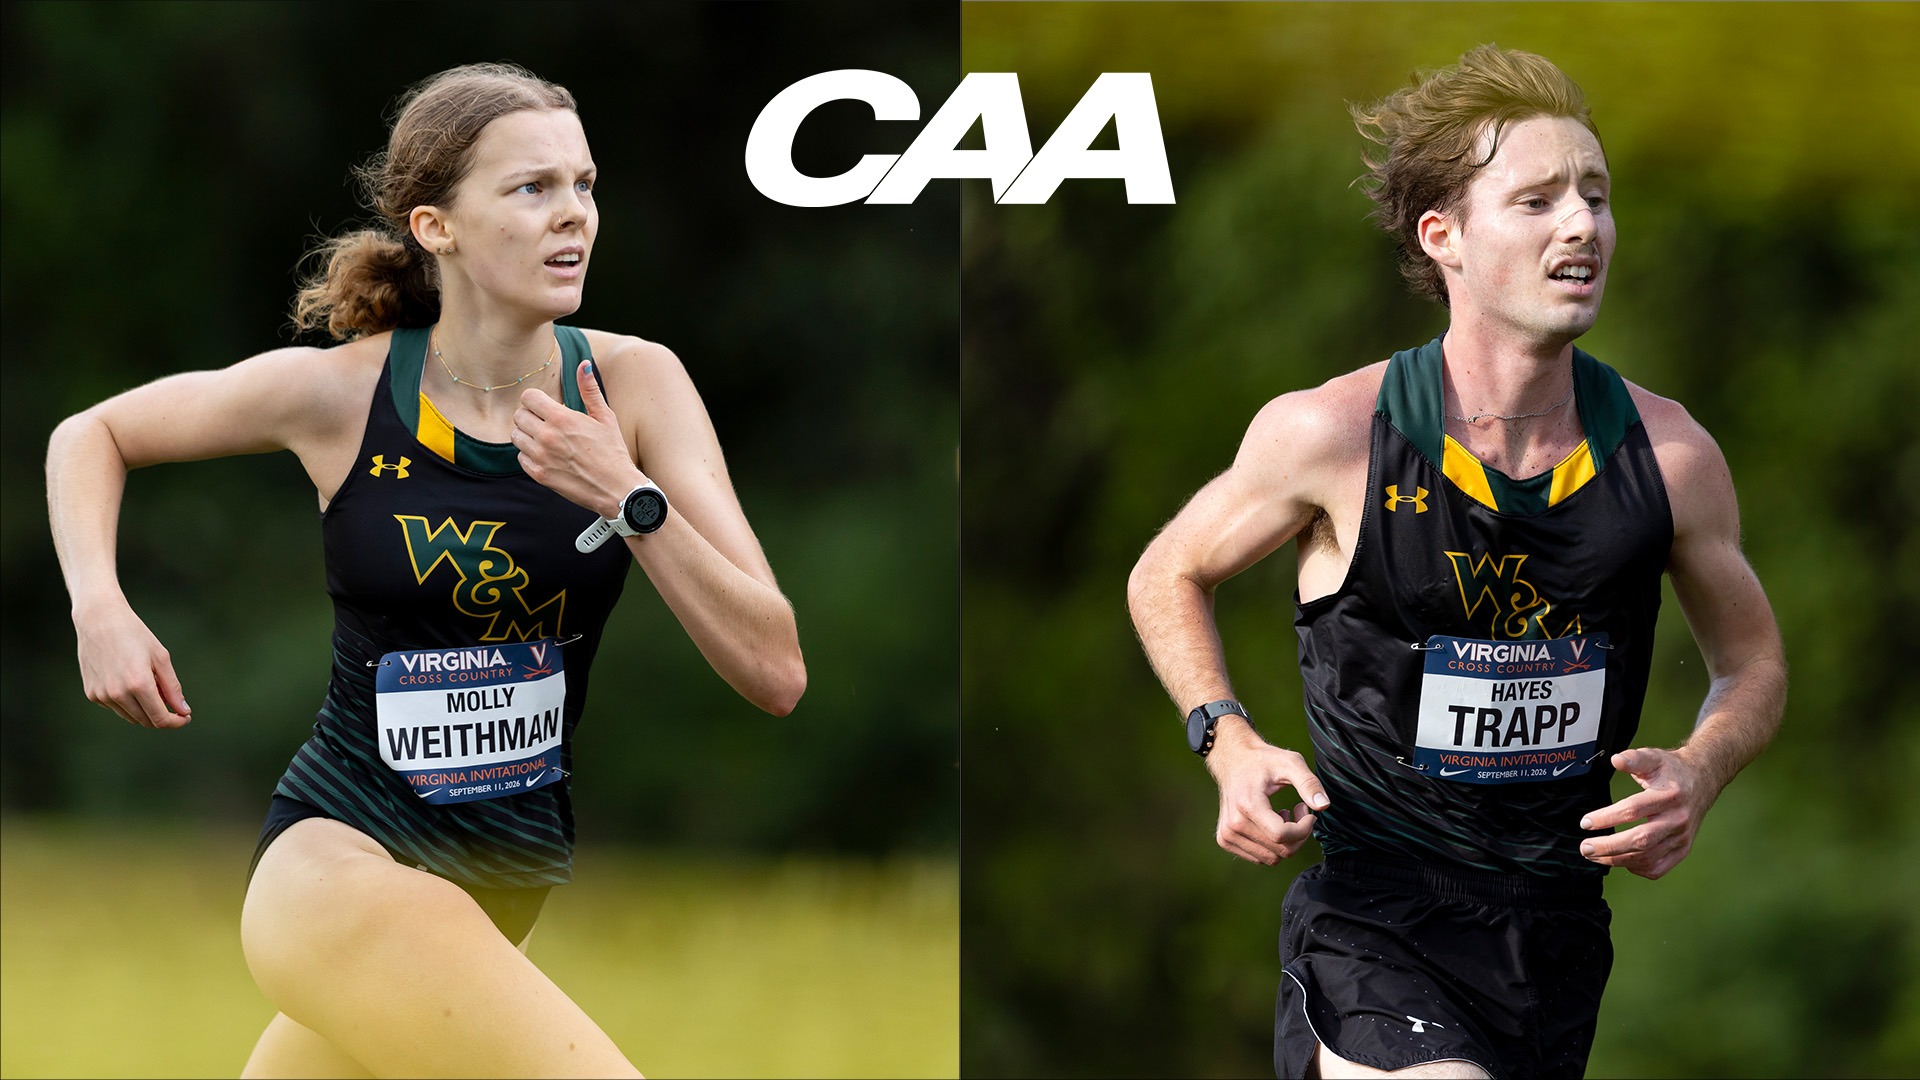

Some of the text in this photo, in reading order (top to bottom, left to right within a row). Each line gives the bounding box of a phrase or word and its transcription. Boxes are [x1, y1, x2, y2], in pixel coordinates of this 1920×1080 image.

[393, 514, 566, 642] W&M
[400, 648, 507, 673] VIRGINIA
[1452, 640, 1551, 663] VIRGINIA
[399, 667, 513, 685] CROSS COUNTRY
[1448, 660, 1556, 674] CROSS COUNTRY
[446, 686, 515, 713] MOLLY
[1491, 680, 1553, 702] HAYES
[386, 706, 559, 761] WEITHMAN
[1448, 702, 1581, 748] TRAPP
[1439, 749, 1577, 768] VIRGINIA INVITATIONAL
[407, 757, 547, 786] VIRGINIA INVITATIONAL
[1477, 770, 1518, 779] SEPTEMBER
[1530, 768, 1547, 776] 2026
[449, 785, 492, 797] SEPTEMBER
[504, 780, 521, 790] 2026
